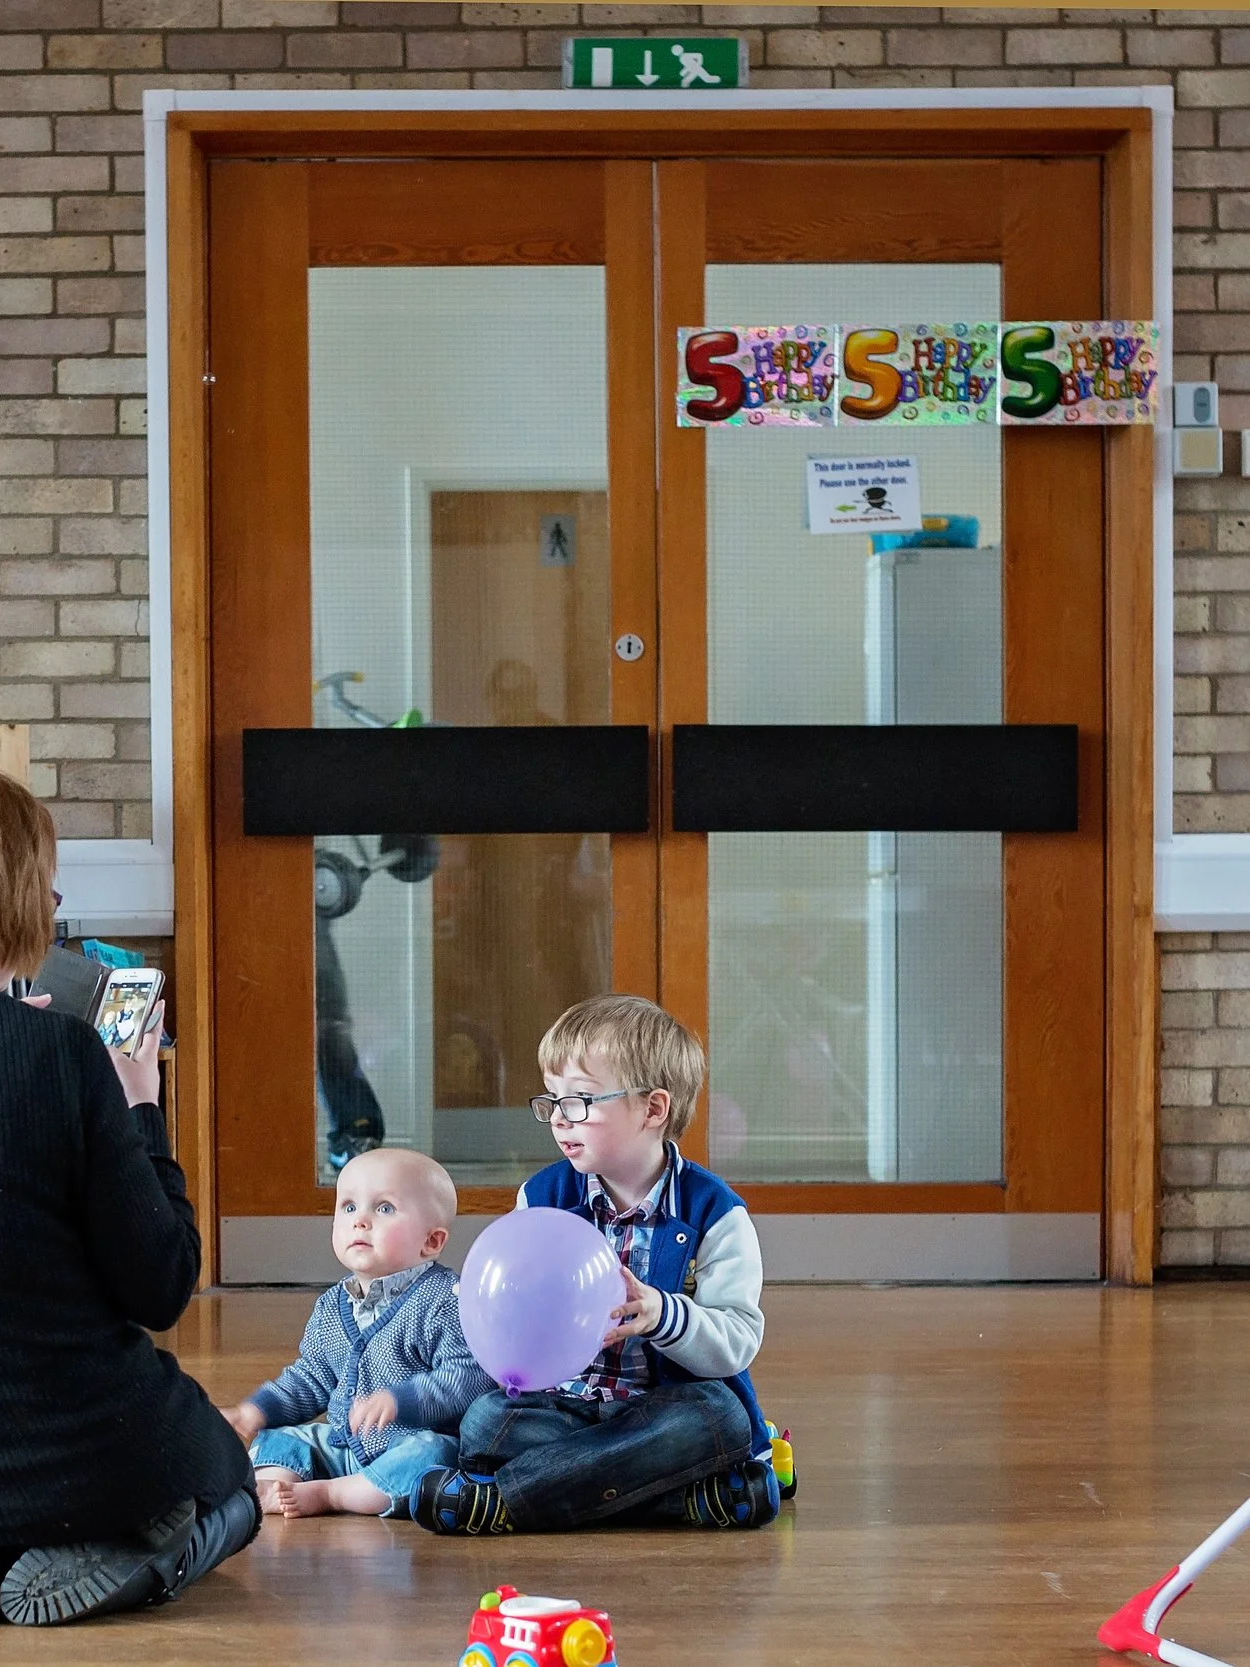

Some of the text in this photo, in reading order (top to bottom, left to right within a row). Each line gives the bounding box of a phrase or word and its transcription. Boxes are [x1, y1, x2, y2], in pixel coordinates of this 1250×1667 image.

[752, 340, 827, 377] Happy
[912, 337, 988, 372] Happy
[1001, 326, 1062, 418] 5
[1068, 336, 1145, 372] Happy
[685, 331, 746, 421] 5
[742, 368, 839, 408] Birthday
[841, 328, 902, 420] 5
[898, 367, 996, 404] Birthday
[1060, 365, 1158, 405] Birthday
[814, 463, 829, 472] This
[831, 462, 846, 471] door
[847, 462, 853, 470] is
[855, 460, 885, 471] normally
[819, 479, 842, 488] Please
[858, 478, 869, 486] the
[871, 477, 888, 485] other
